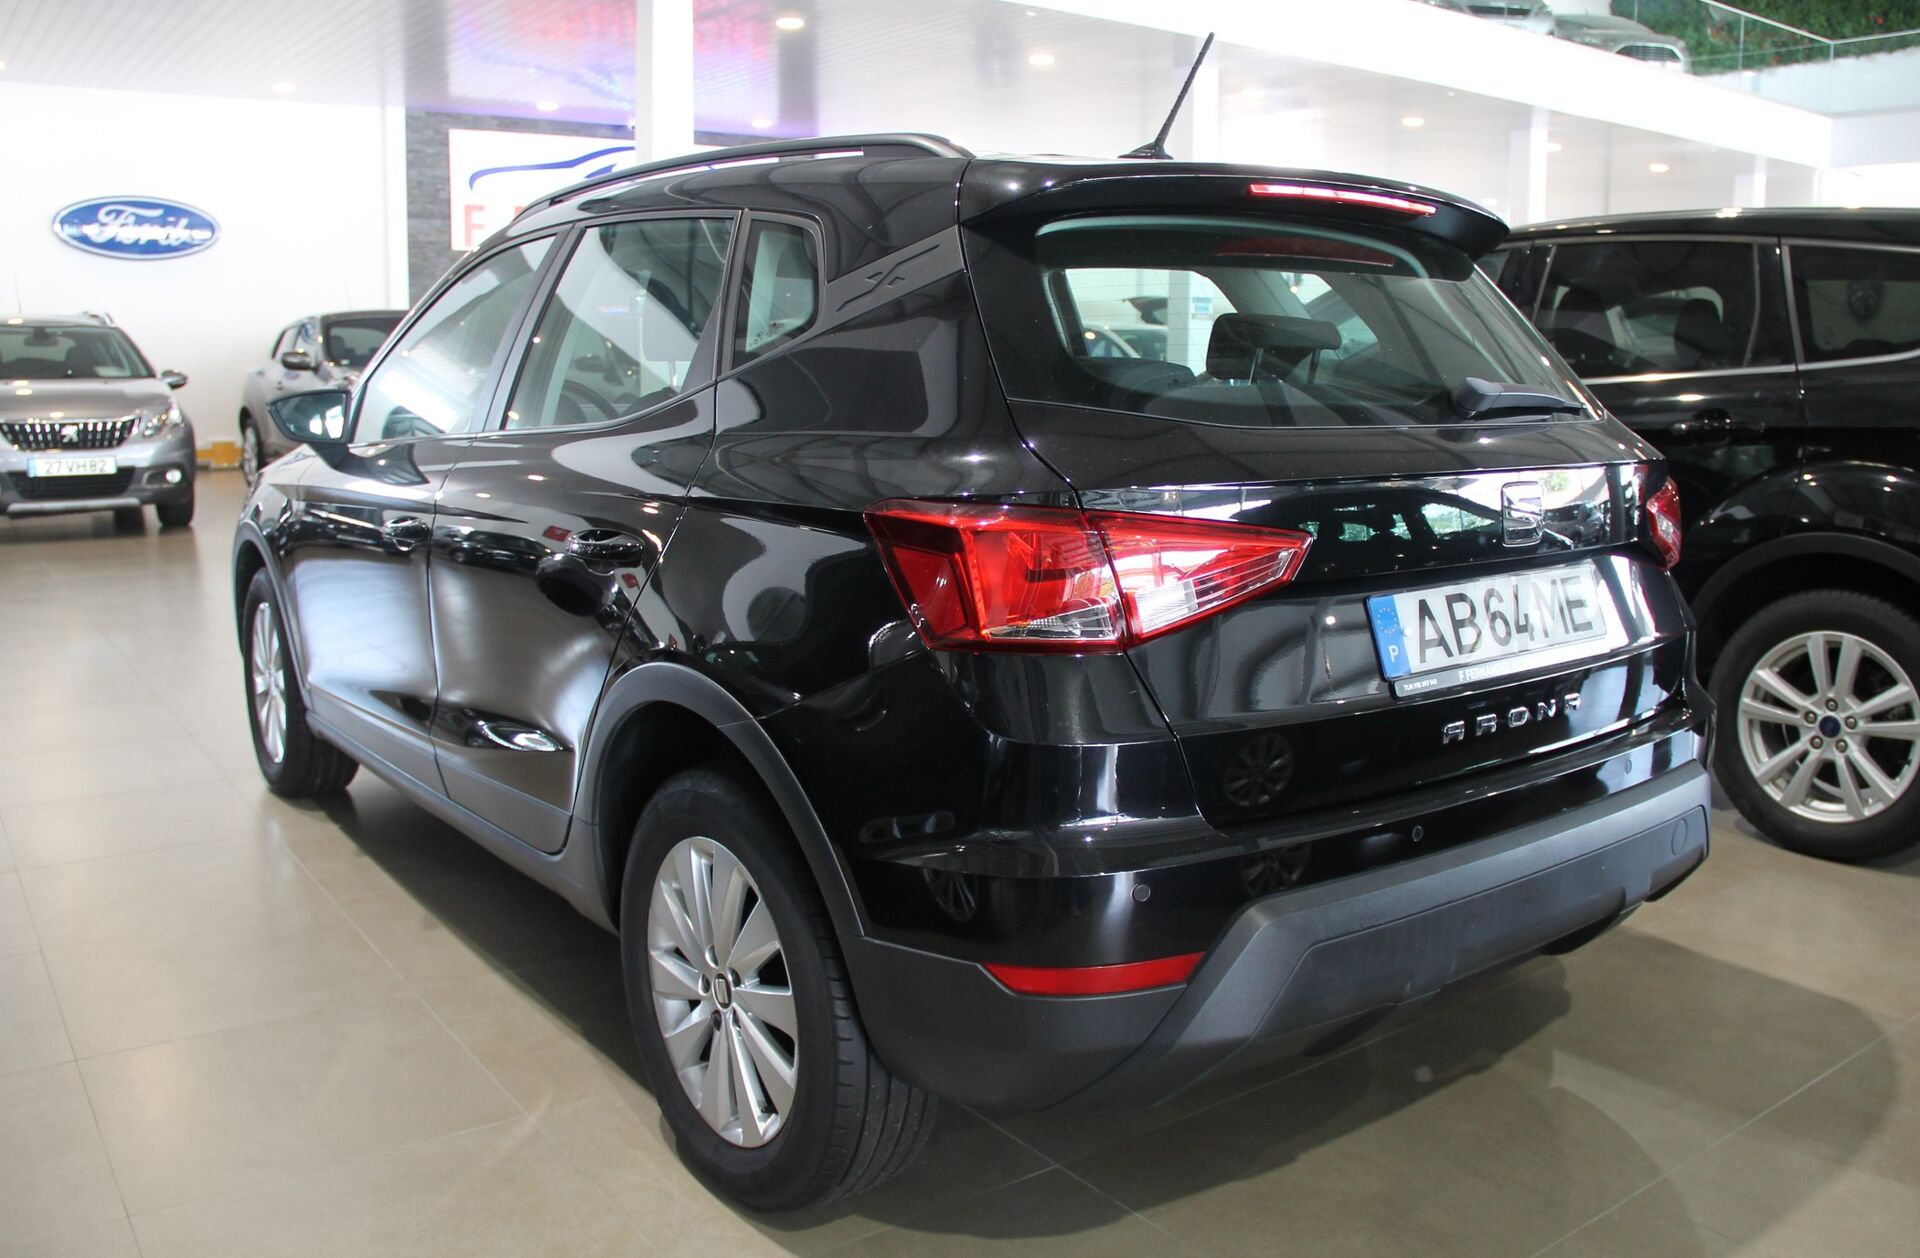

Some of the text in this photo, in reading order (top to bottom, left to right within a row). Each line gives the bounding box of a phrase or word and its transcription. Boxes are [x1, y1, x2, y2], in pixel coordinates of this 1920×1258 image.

[87, 204, 190, 246] Ford
[1388, 645, 1399, 663] P
[1442, 692, 1581, 745] ARONA
